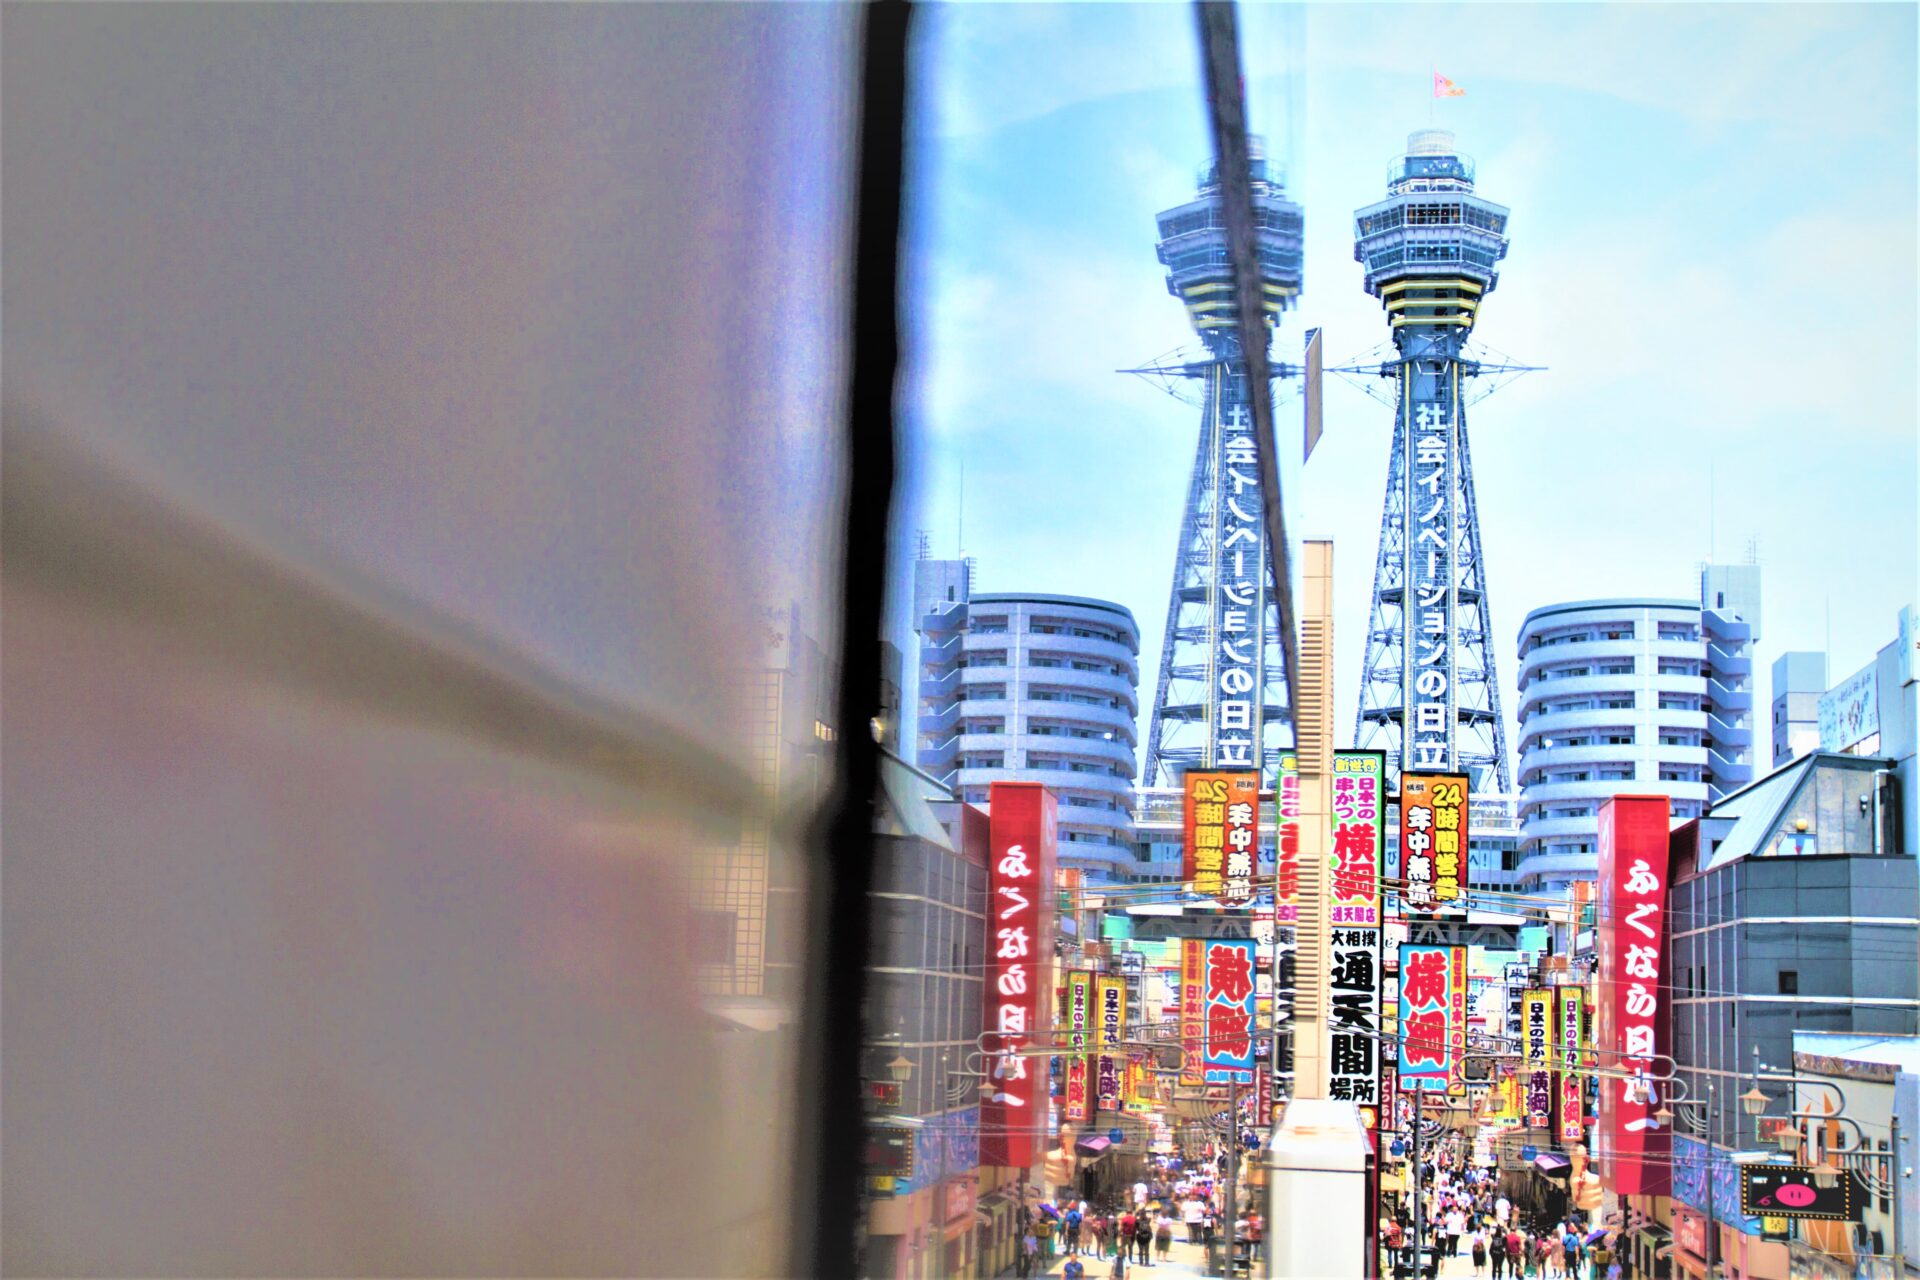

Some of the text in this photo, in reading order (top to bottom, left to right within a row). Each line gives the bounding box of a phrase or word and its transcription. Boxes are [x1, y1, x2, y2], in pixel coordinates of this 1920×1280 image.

[1416, 403, 1447, 769] 社会イノベーションの日立
[1334, 776, 1355, 819] 串かつ
[1358, 776, 1376, 820] 日本一の
[1333, 822, 1377, 902] 横綱
[1407, 805, 1432, 905] 年中無休
[1432, 783, 1464, 900] 24時間営業
[1330, 929, 1377, 947] 大相撲
[1331, 906, 1376, 923] 通天閣店
[1330, 950, 1376, 1076] 通天閣
[1403, 951, 1448, 1067] 横綱
[1329, 1077, 1376, 1102] 場所
